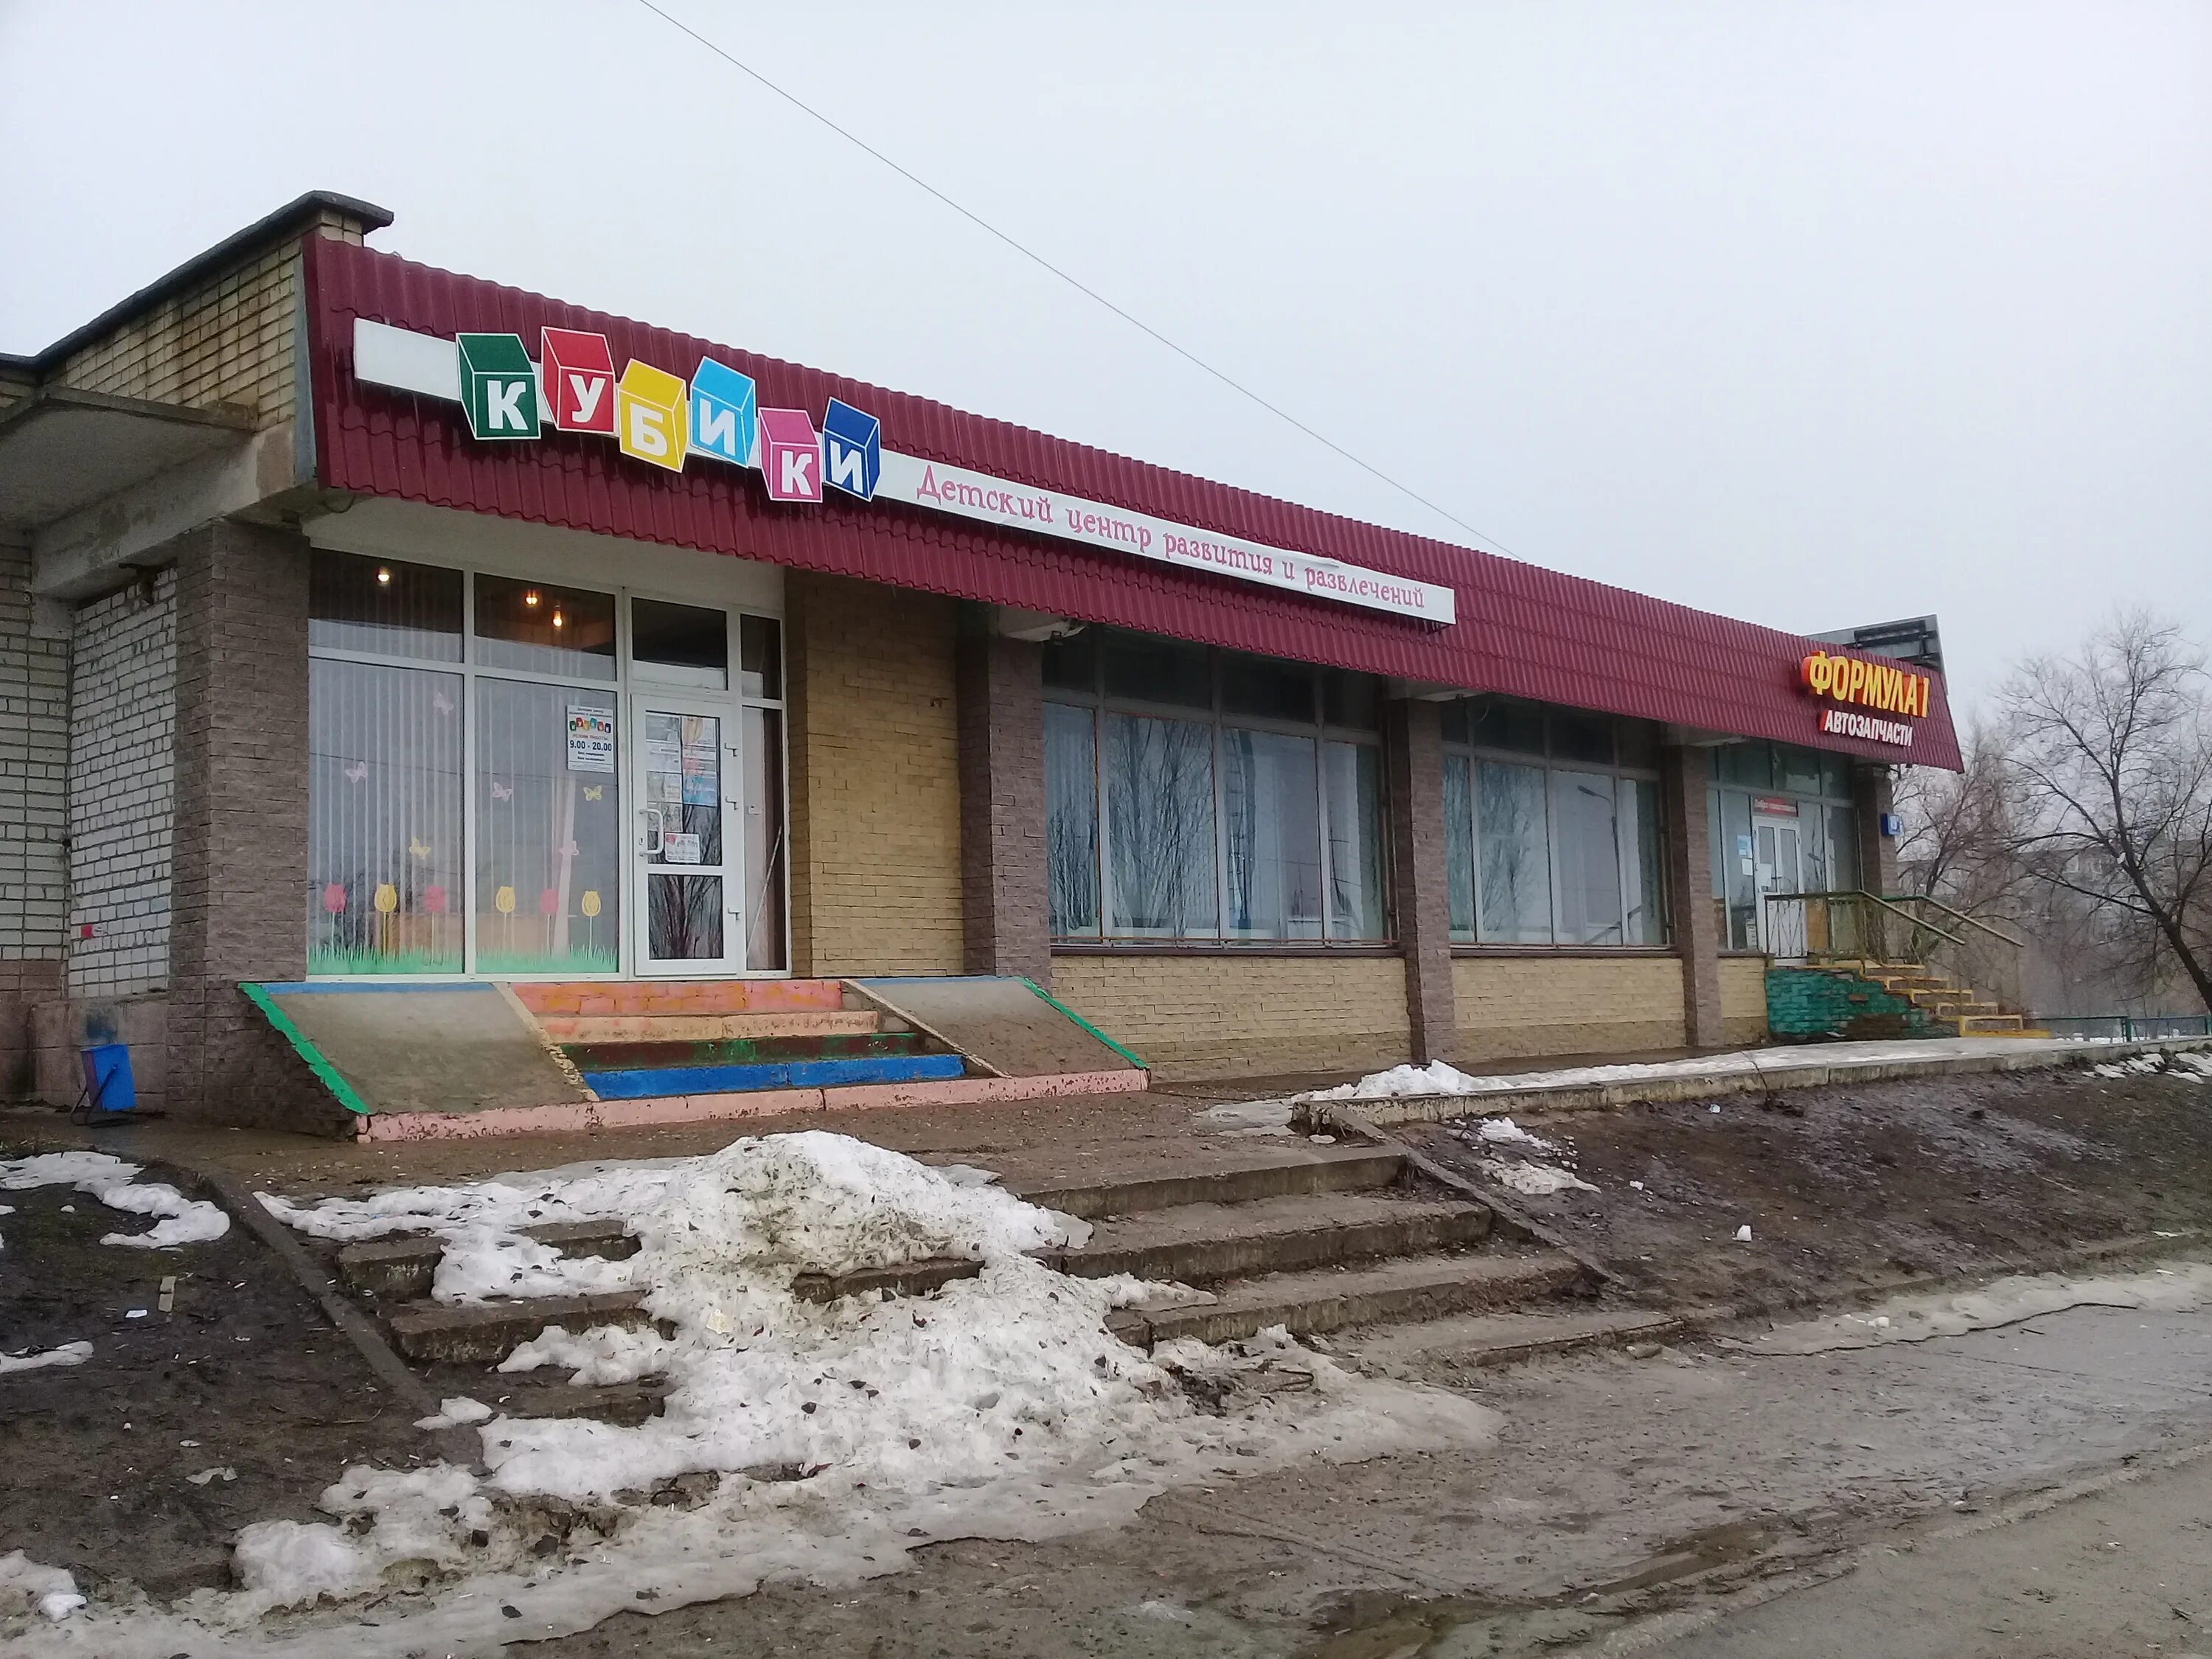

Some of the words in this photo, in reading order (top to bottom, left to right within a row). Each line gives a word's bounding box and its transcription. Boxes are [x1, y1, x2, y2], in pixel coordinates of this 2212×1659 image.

[487, 374, 865, 495] КУБИКИ
[917, 465, 1054, 524] Детский
[1065, 507, 1152, 553] центр
[1163, 532, 1273, 574] развития
[1281, 560, 1295, 580] и
[1304, 566, 1425, 608] развлечений
[569, 740, 585, 749] 9.00
[592, 742, 612, 751] 20.00
[1824, 709, 1913, 747] АВТОЗАПЧАСТИ
